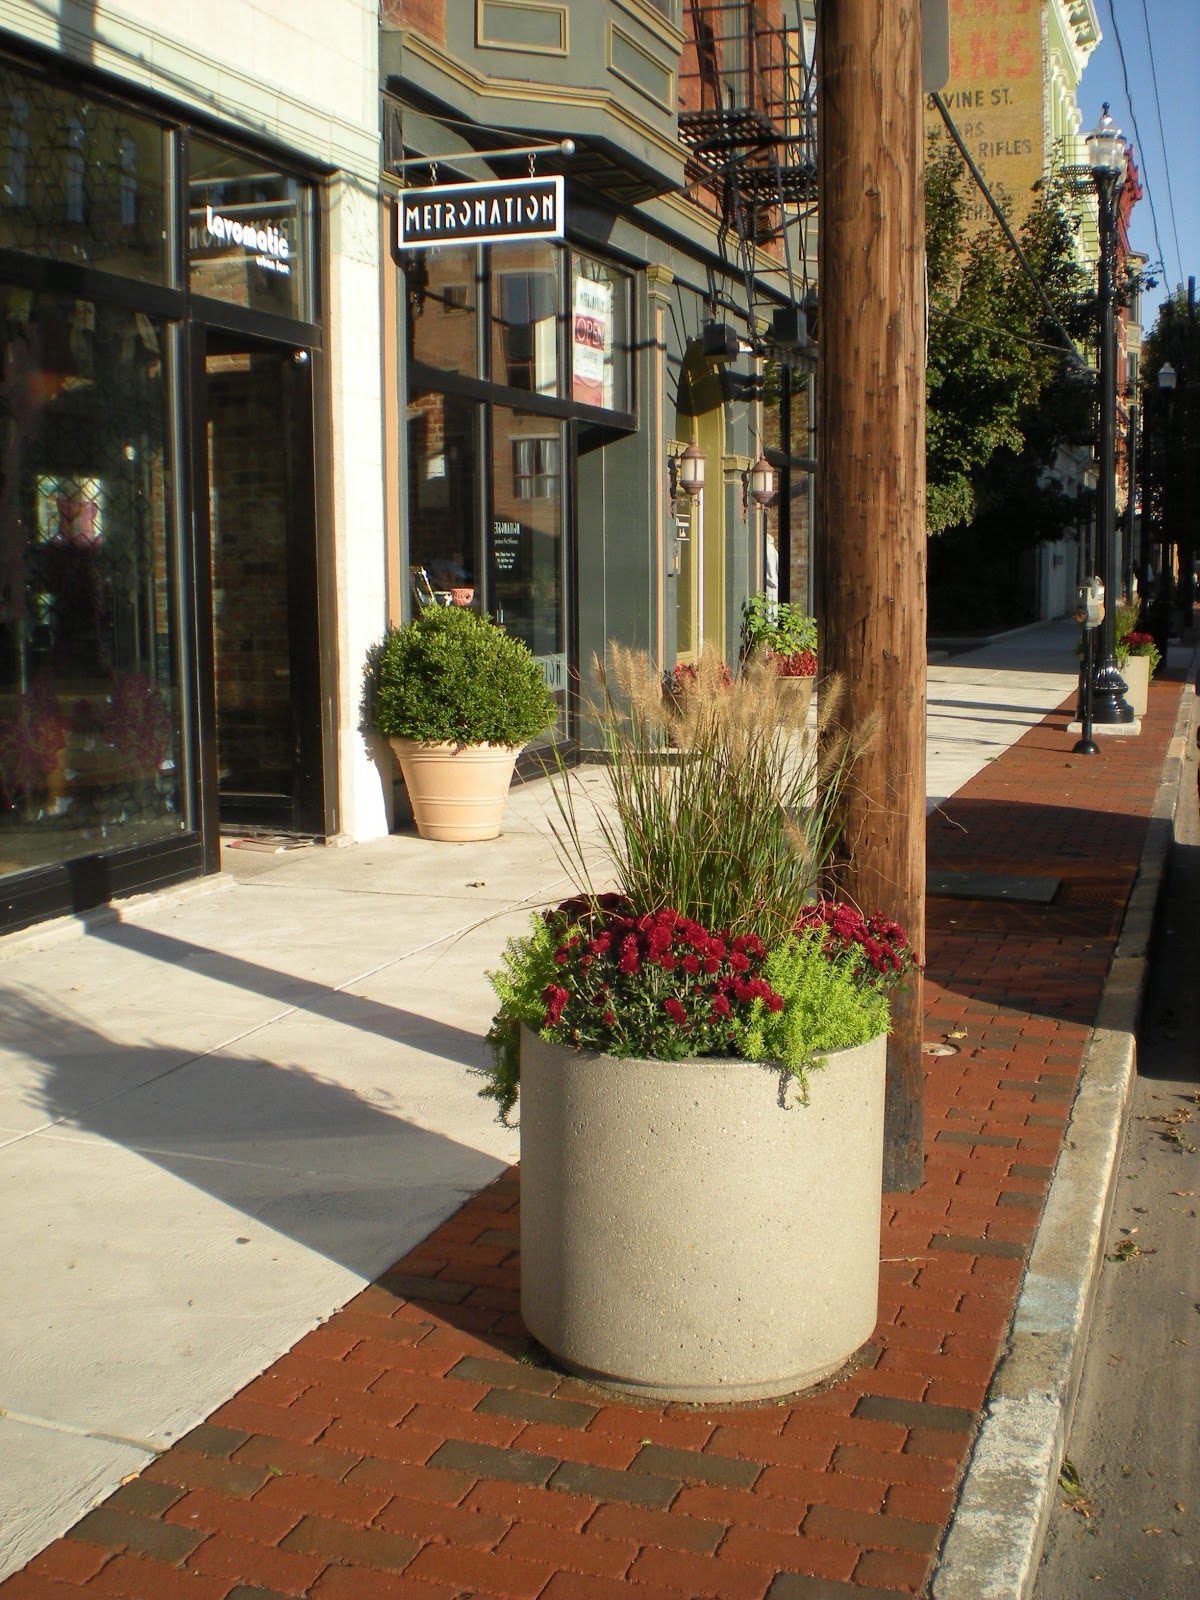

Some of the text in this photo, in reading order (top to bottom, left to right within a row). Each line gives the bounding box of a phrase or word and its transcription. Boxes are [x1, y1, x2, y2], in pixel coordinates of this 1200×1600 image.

[942, 90, 984, 108] VINE
[991, 87, 1013, 106] ST.
[978, 139, 1032, 158] RIFLES
[405, 194, 553, 231] METRONATION
[206, 205, 289, 259] Lavomatic
[576, 317, 605, 346] OPEN
